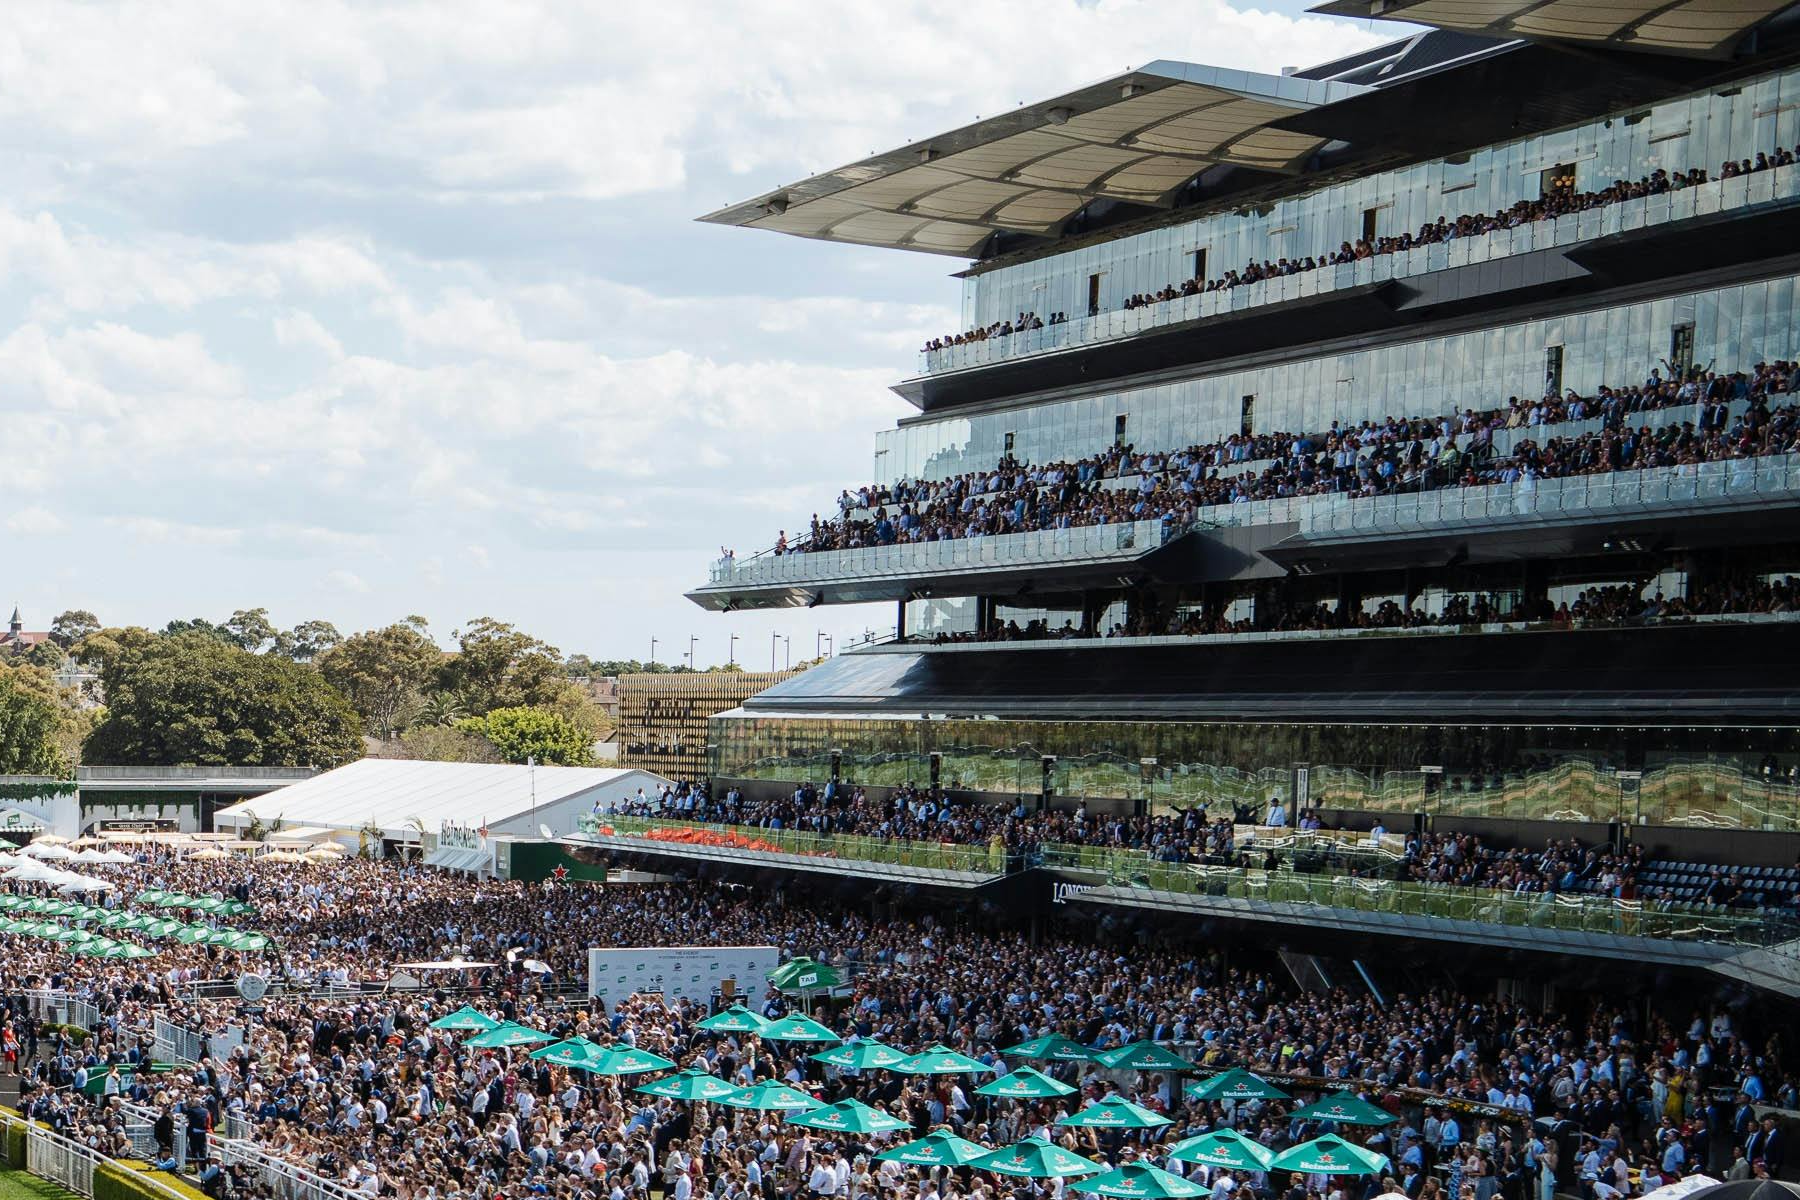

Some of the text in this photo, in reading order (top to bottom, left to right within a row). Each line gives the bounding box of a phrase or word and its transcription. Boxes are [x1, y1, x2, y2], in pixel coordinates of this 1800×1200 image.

[800, 976, 817, 984] TAB
[1313, 1111, 1358, 1121] Heineken
[1195, 1152, 1243, 1166] Heineken
[1300, 1161, 1350, 1171] Heineken
